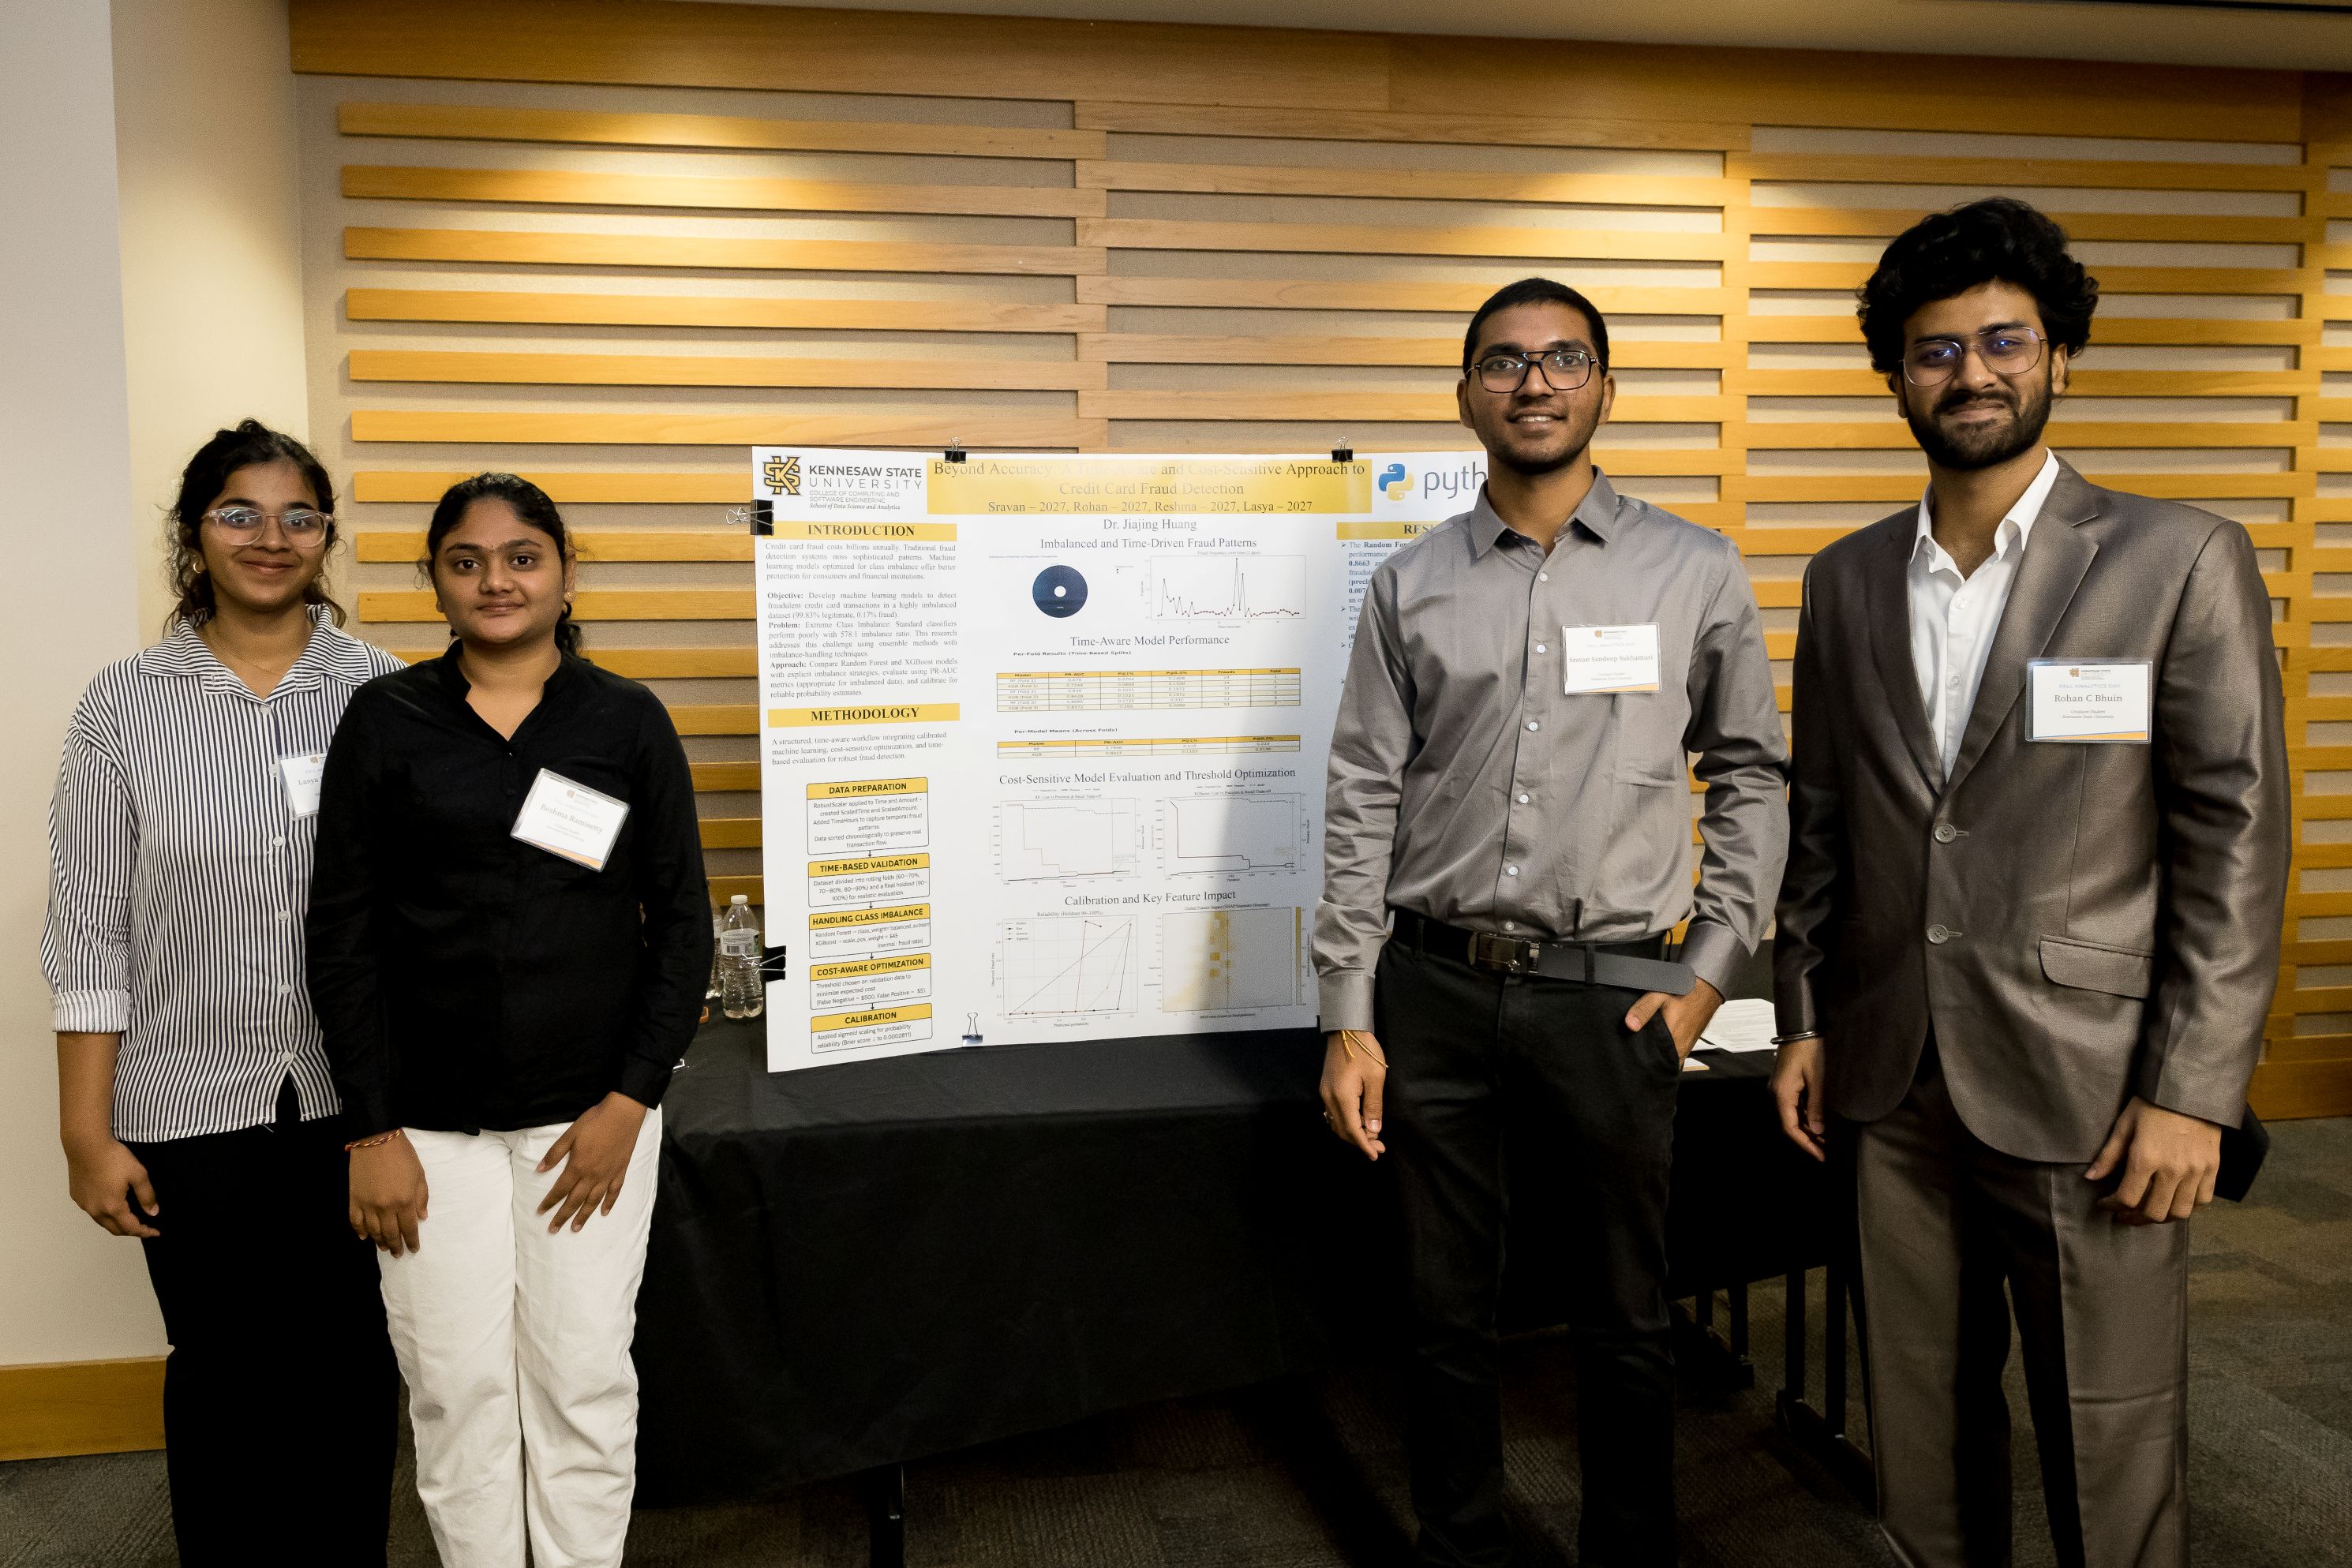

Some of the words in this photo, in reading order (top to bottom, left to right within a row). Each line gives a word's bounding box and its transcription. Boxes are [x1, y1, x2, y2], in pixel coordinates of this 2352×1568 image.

[809, 465, 883, 477] KENNESAW
[886, 467, 922, 478] STATE
[934, 462, 984, 477] Beyond
[1161, 464, 1183, 474] and
[1189, 464, 1282, 474] Cost-Sensitive
[1286, 463, 1347, 478] Approach
[1353, 465, 1365, 474] to
[809, 478, 922, 490] UNIVERSITY
[1059, 482, 1099, 495] Credit
[1105, 483, 1136, 495] Card
[1140, 483, 1177, 495] Fraud
[1183, 482, 1244, 495] Detection
[988, 502, 1025, 512] Sravan
[1073, 502, 1107, 512] Rohan
[1155, 501, 1197, 511] Reshma
[1244, 501, 1274, 513] Lasya
[1287, 501, 1312, 511] 2027
[807, 525, 915, 536] INTRODUCTION
[1103, 519, 1119, 530] Dr.
[1123, 518, 1159, 532] Jiajing
[1162, 519, 1197, 531] Huang
[1403, 524, 1437, 533] RES
[1041, 539, 1097, 548] Imbalanced
[1101, 538, 1118, 548] and
[1122, 538, 1184, 548] Time-Driven
[1188, 538, 1215, 548] Fraud
[1219, 538, 1257, 548] Patterns
[1070, 637, 1131, 646] Time-Aware
[1134, 636, 1165, 646] Model
[1169, 635, 1230, 646] Performance
[811, 707, 919, 721] METHODOLOGY
[999, 774, 1071, 784] Cost-Sensitive
[1074, 773, 1105, 783] Model
[1109, 772, 1161, 782] Evaluation
[1164, 772, 1182, 780] and
[1185, 769, 1231, 780] Threshold
[1234, 768, 1296, 780] Optimization
[852, 783, 907, 792] PREPARATION
[540, 803, 568, 820] Reshma
[570, 814, 604, 833] Ramisetty
[820, 862, 869, 872] TIME-BASED
[871, 859, 918, 869] VALIDATION
[1065, 896, 1119, 905] Calibration
[1123, 895, 1140, 904] and
[1144, 893, 1163, 904] Key
[1166, 893, 1200, 902] Feature
[1204, 891, 1236, 902] Impact
[813, 915, 853, 925] HANDLING
[881, 908, 923, 918] IMBALANCE
[817, 965, 868, 976] COST-AWARE
[871, 958, 923, 971] OPTIMIZATION
[845, 1012, 897, 1024] CALIBRATION
